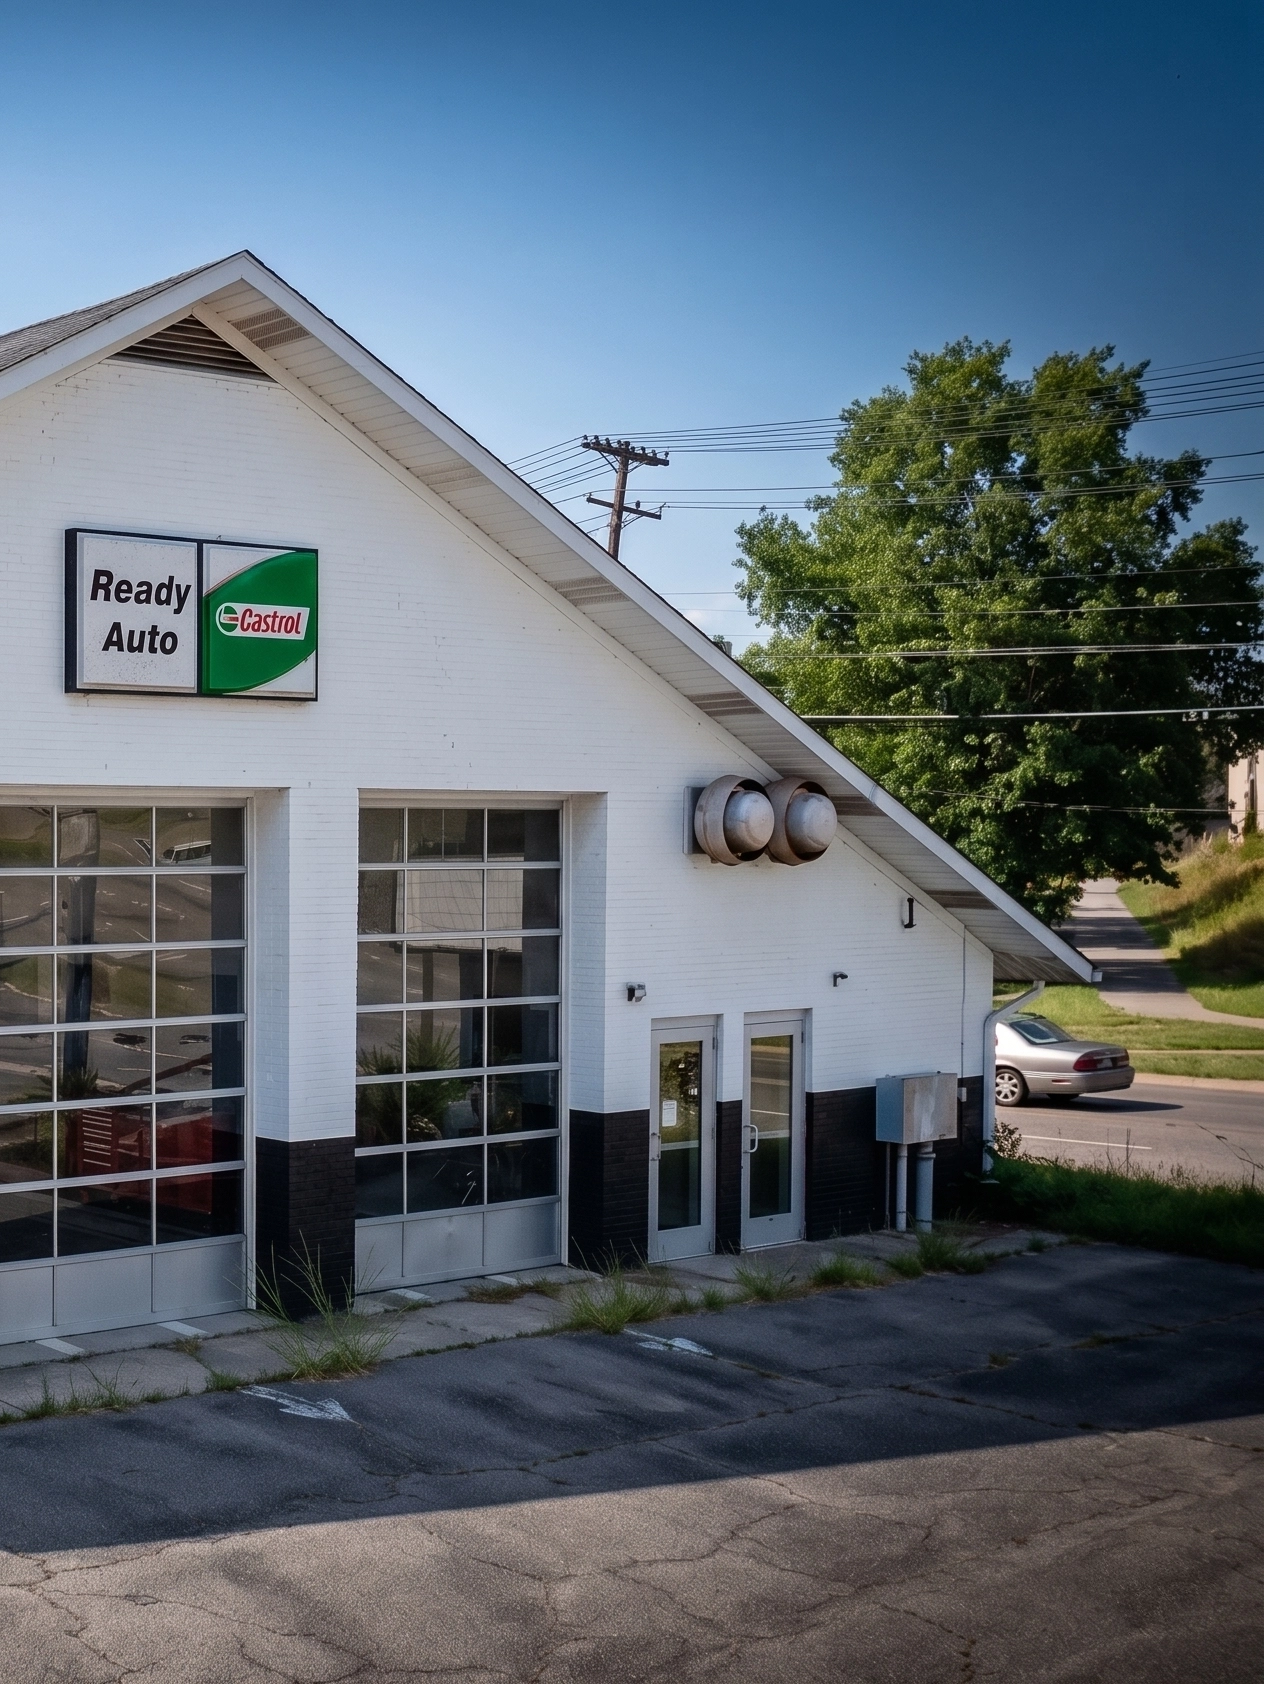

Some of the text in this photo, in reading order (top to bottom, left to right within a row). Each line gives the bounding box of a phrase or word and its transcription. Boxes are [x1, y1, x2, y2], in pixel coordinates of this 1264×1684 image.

[90, 569, 192, 615] Ready
[101, 621, 178, 655] Auto
[240, 608, 302, 635] Castrol
